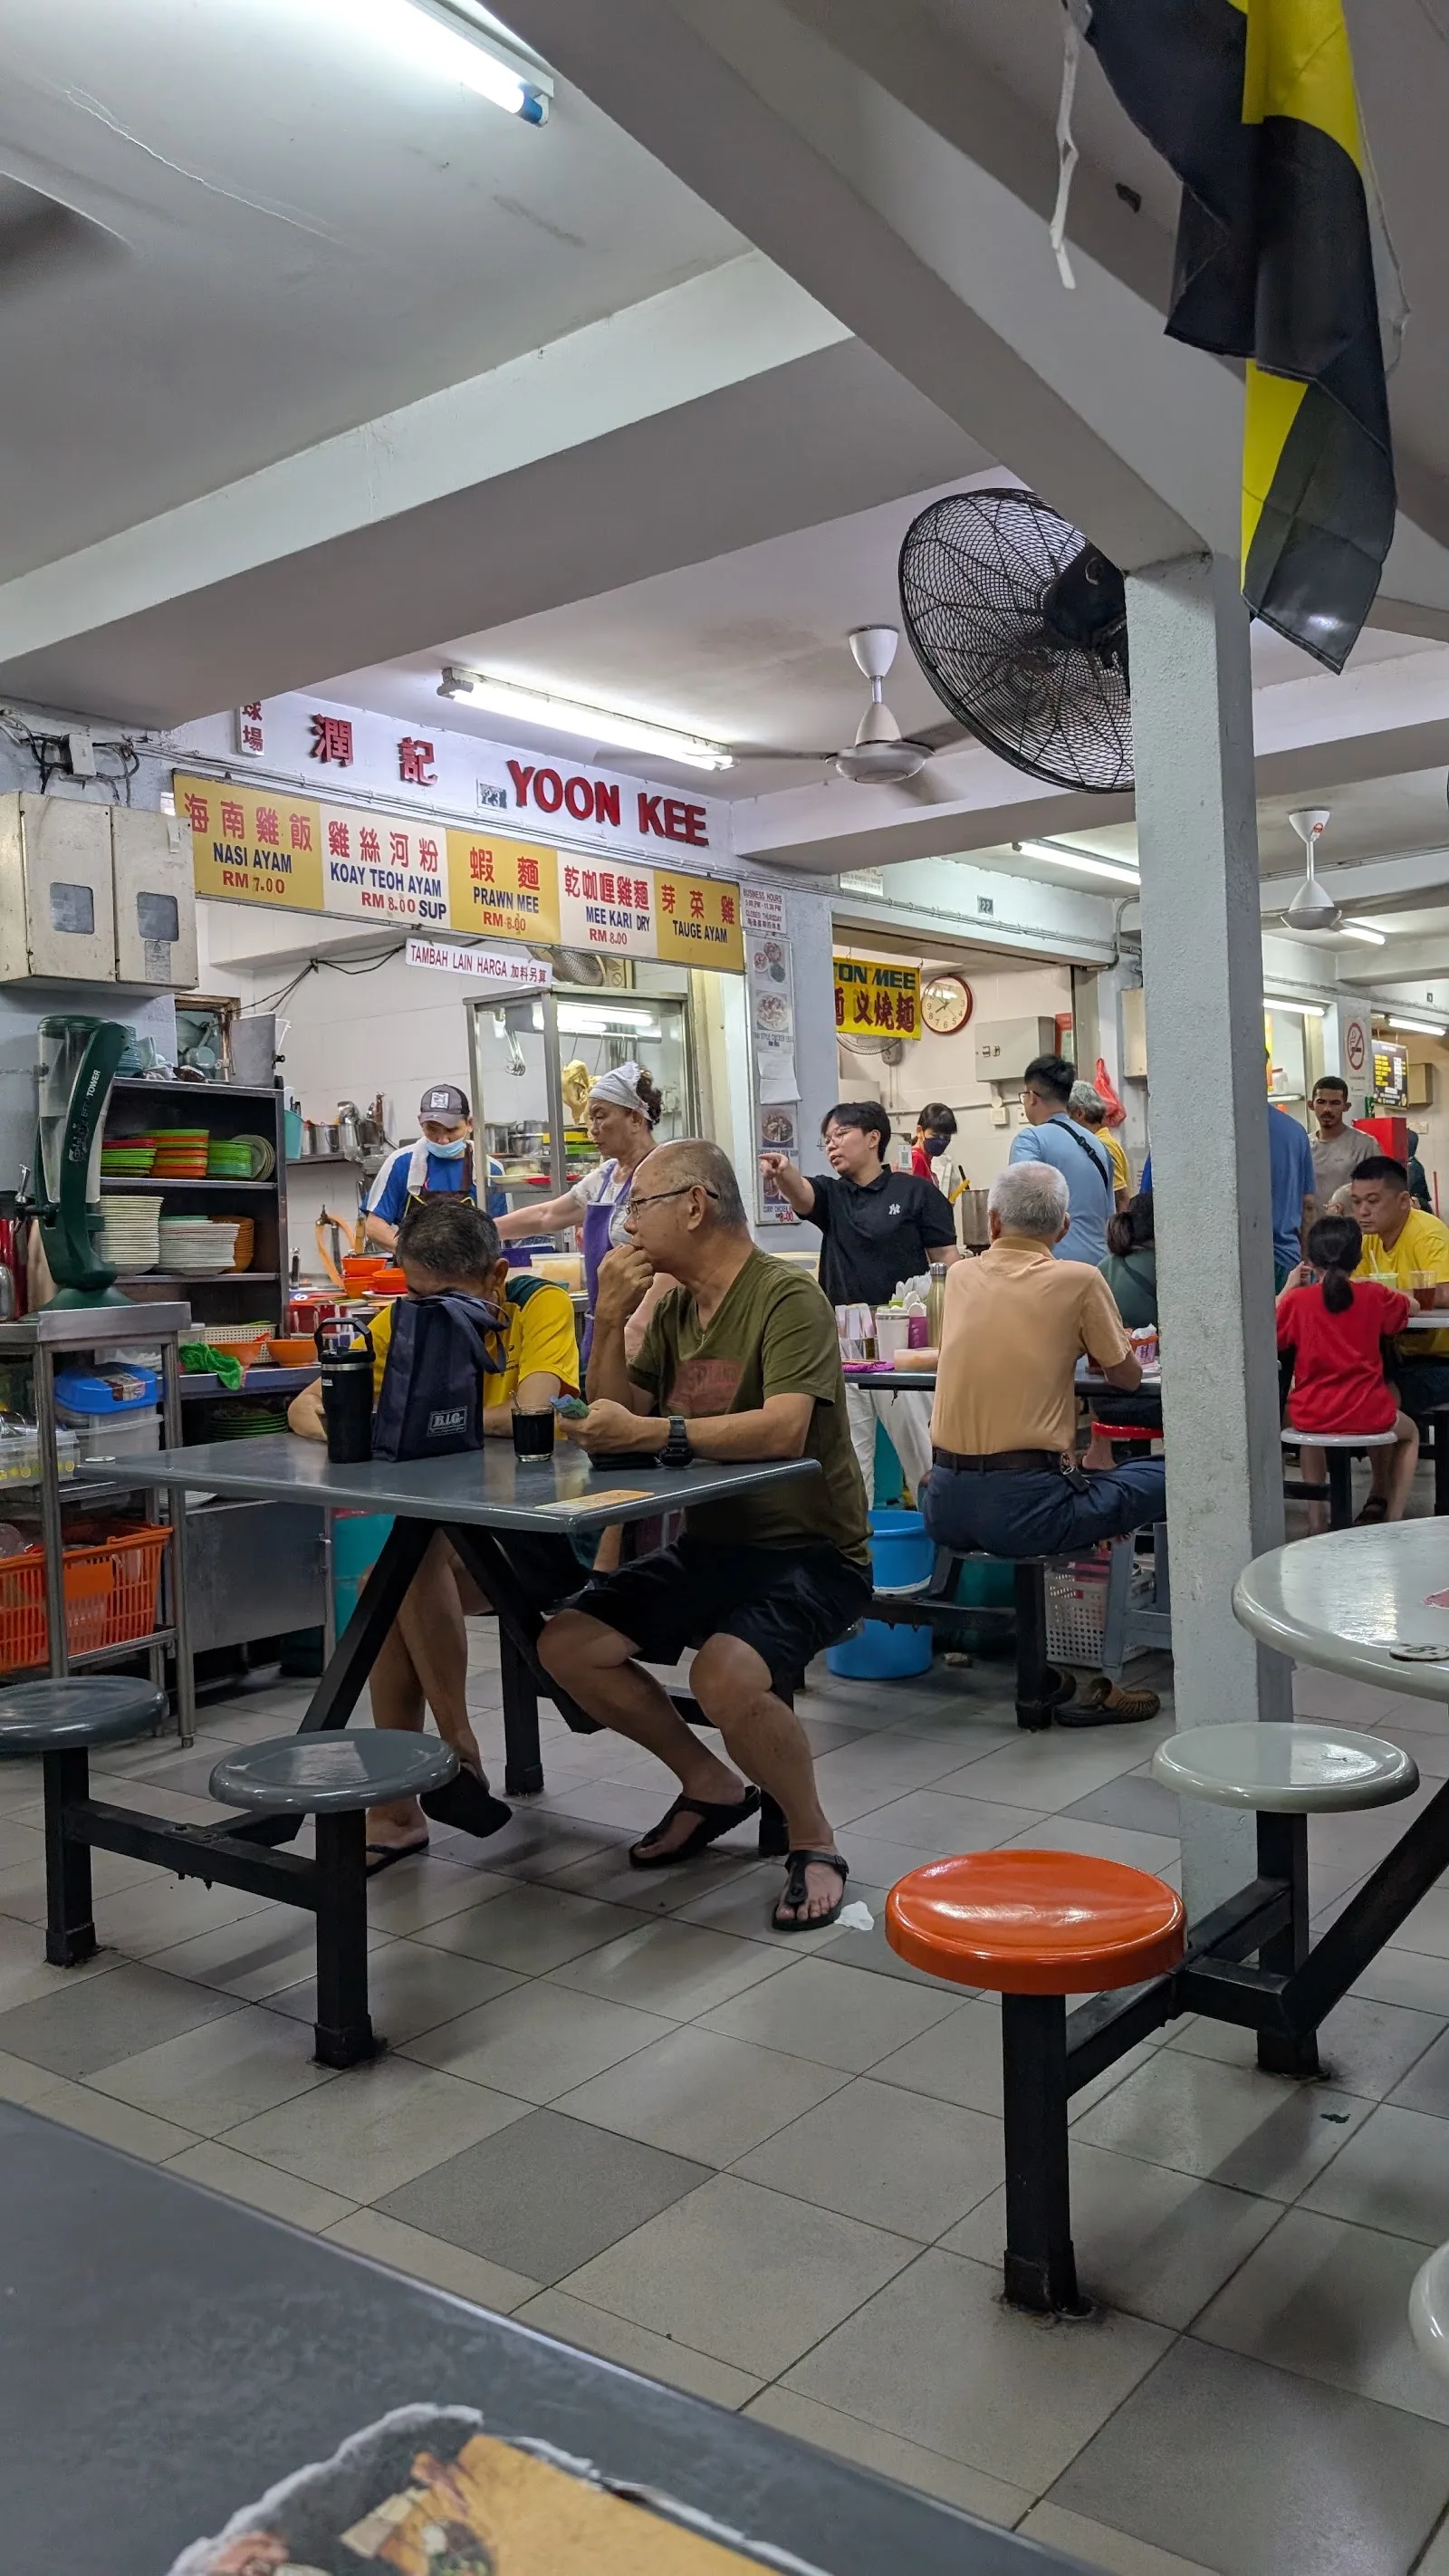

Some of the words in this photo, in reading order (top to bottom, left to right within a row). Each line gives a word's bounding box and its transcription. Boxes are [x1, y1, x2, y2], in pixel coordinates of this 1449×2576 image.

[505, 759, 621, 827] YOON
[637, 793, 710, 847] KEE
[184, 792, 313, 852] 海南雞飯
[213, 841, 248, 867] NASI
[253, 849, 293, 874] AYAM
[328, 821, 439, 872] 雞絲河粉
[222, 870, 249, 889] RM
[252, 877, 285, 894] 7.00
[330, 861, 366, 886] KOAY
[369, 868, 405, 892] TEOH
[408, 875, 442, 898] AYAM
[469, 846, 541, 891] 蝦麵
[361, 891, 385, 908] RM
[388, 896, 416, 913] 8.00
[418, 899, 447, 919] SUP
[473, 886, 513, 910] PRAWN
[517, 893, 539, 914] MEE
[661, 884, 735, 925] 芽菜雞
[743, 888, 765, 899] BUSINESS
[766, 892, 782, 904] HOURS
[483, 910, 504, 928] RM
[585, 906, 607, 926] MEE
[609, 909, 633, 929] KARI
[636, 914, 650, 932] DRY
[673, 919, 702, 939] TAUGE
[704, 925, 728, 944] AYAM
[589, 928, 608, 943] RM
[609, 932, 628, 946] 8.00
[410, 945, 448, 967] TAMBAH
[453, 952, 473, 972] LAIN
[476, 956, 507, 977] HARGA
[510, 965, 547, 984] 加料另算
[871, 968, 916, 990] MEE
[86, 1070, 101, 1097] TOWER
